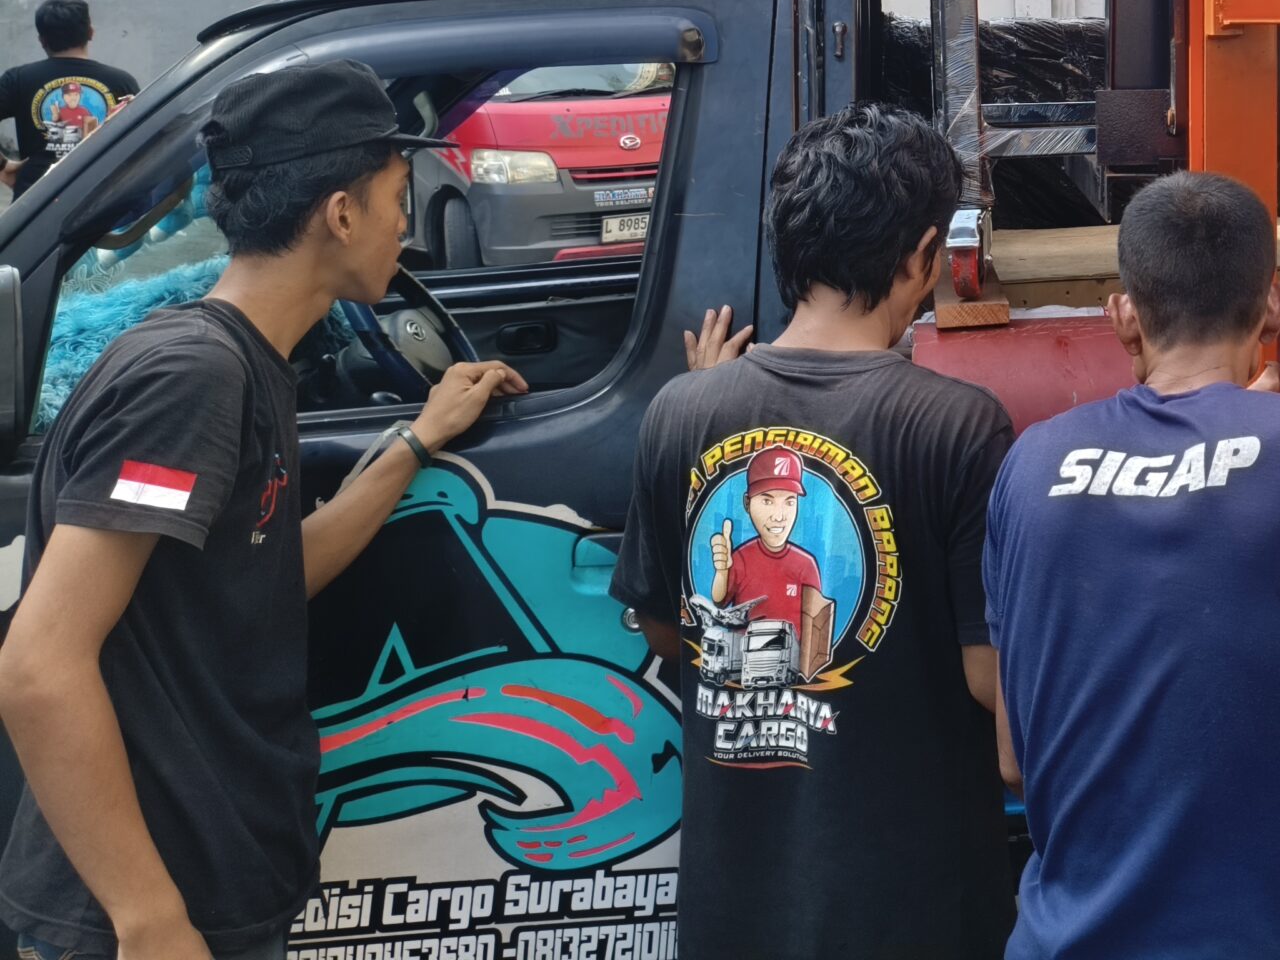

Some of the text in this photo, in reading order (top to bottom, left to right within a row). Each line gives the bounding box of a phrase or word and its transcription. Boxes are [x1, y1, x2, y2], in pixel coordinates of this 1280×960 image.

[605, 217, 647, 233] L 8985
[1048, 436, 1261, 497] SIGAP
[702, 428, 900, 651] PENGIRIMAN BARANG
[696, 683, 839, 734] MAKHARYA
[714, 751, 735, 759] YOUR
[738, 750, 775, 758] DELIVERY
[715, 721, 809, 753] CARGO
[382, 883, 495, 930] Cargo
[504, 870, 678, 916] Surabaya
